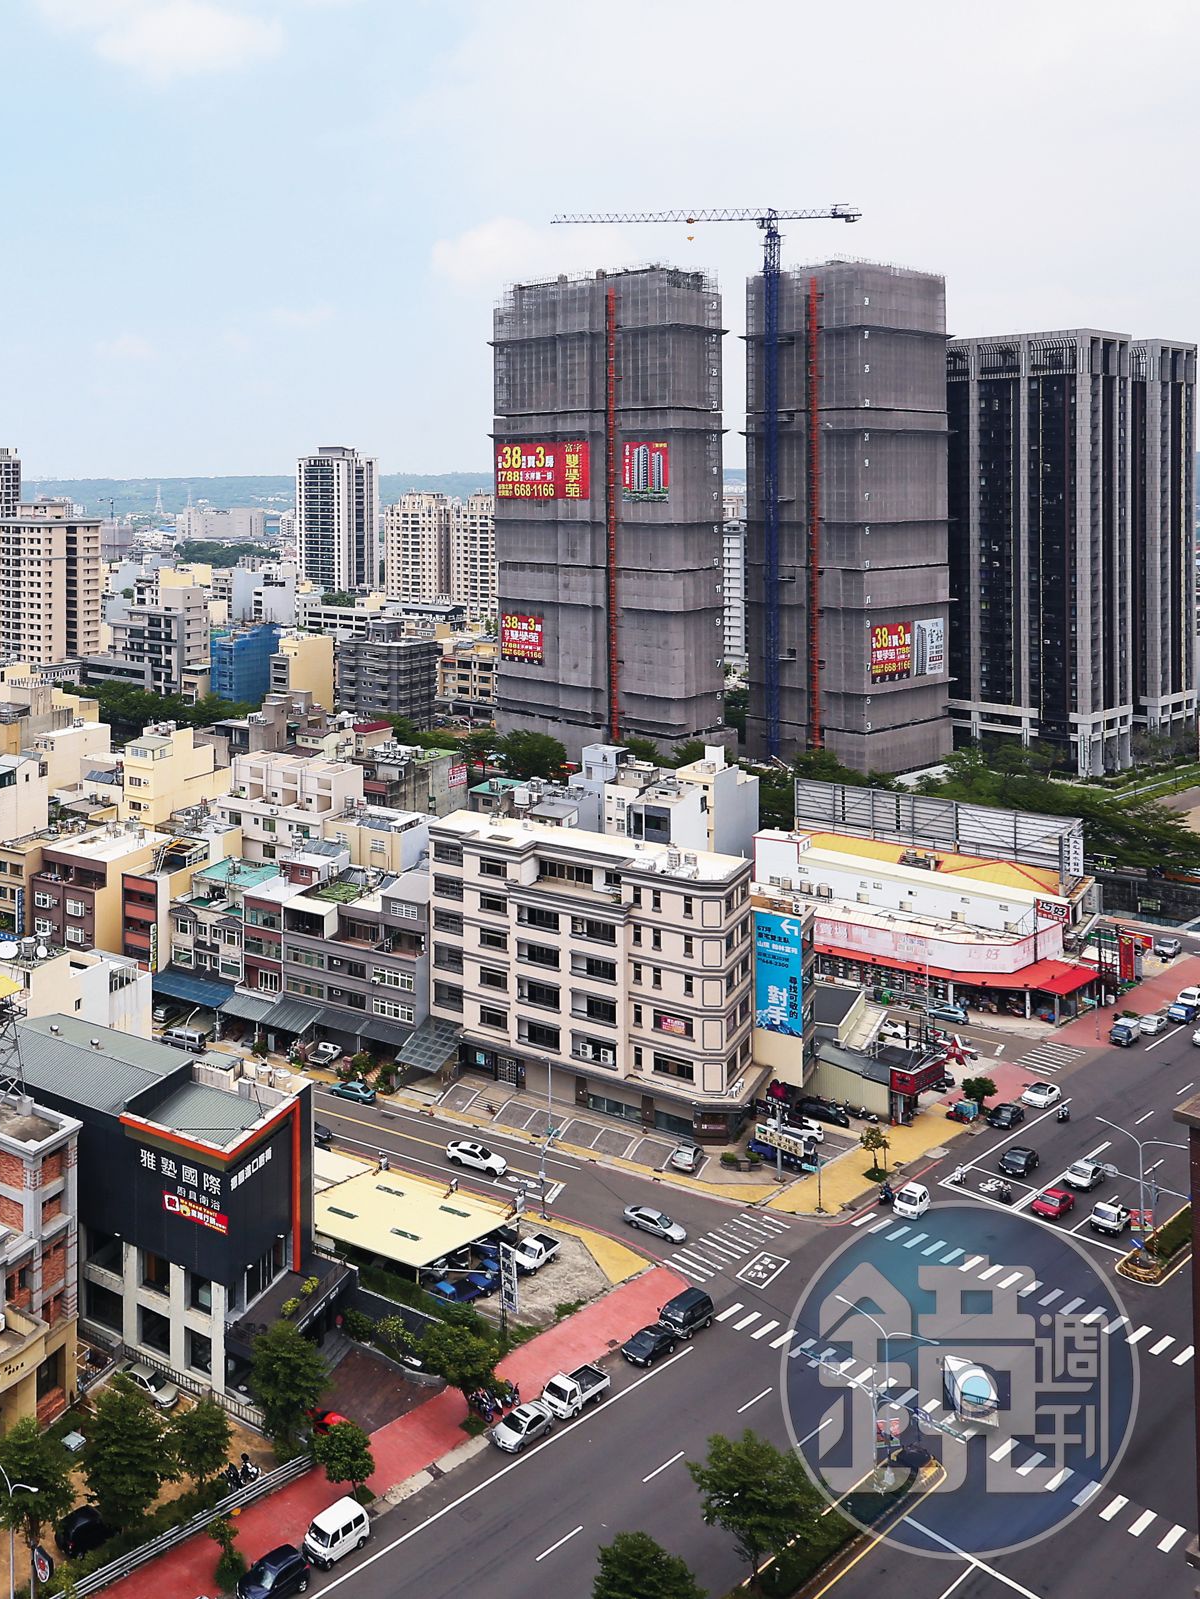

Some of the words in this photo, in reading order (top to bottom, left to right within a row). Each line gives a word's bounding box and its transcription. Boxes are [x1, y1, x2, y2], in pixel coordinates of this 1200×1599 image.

[1039, 901, 1067, 917] 巧好
[767, 985, 789, 1026] 對手
[176, 1185, 221, 1211] 廚具衛浴
